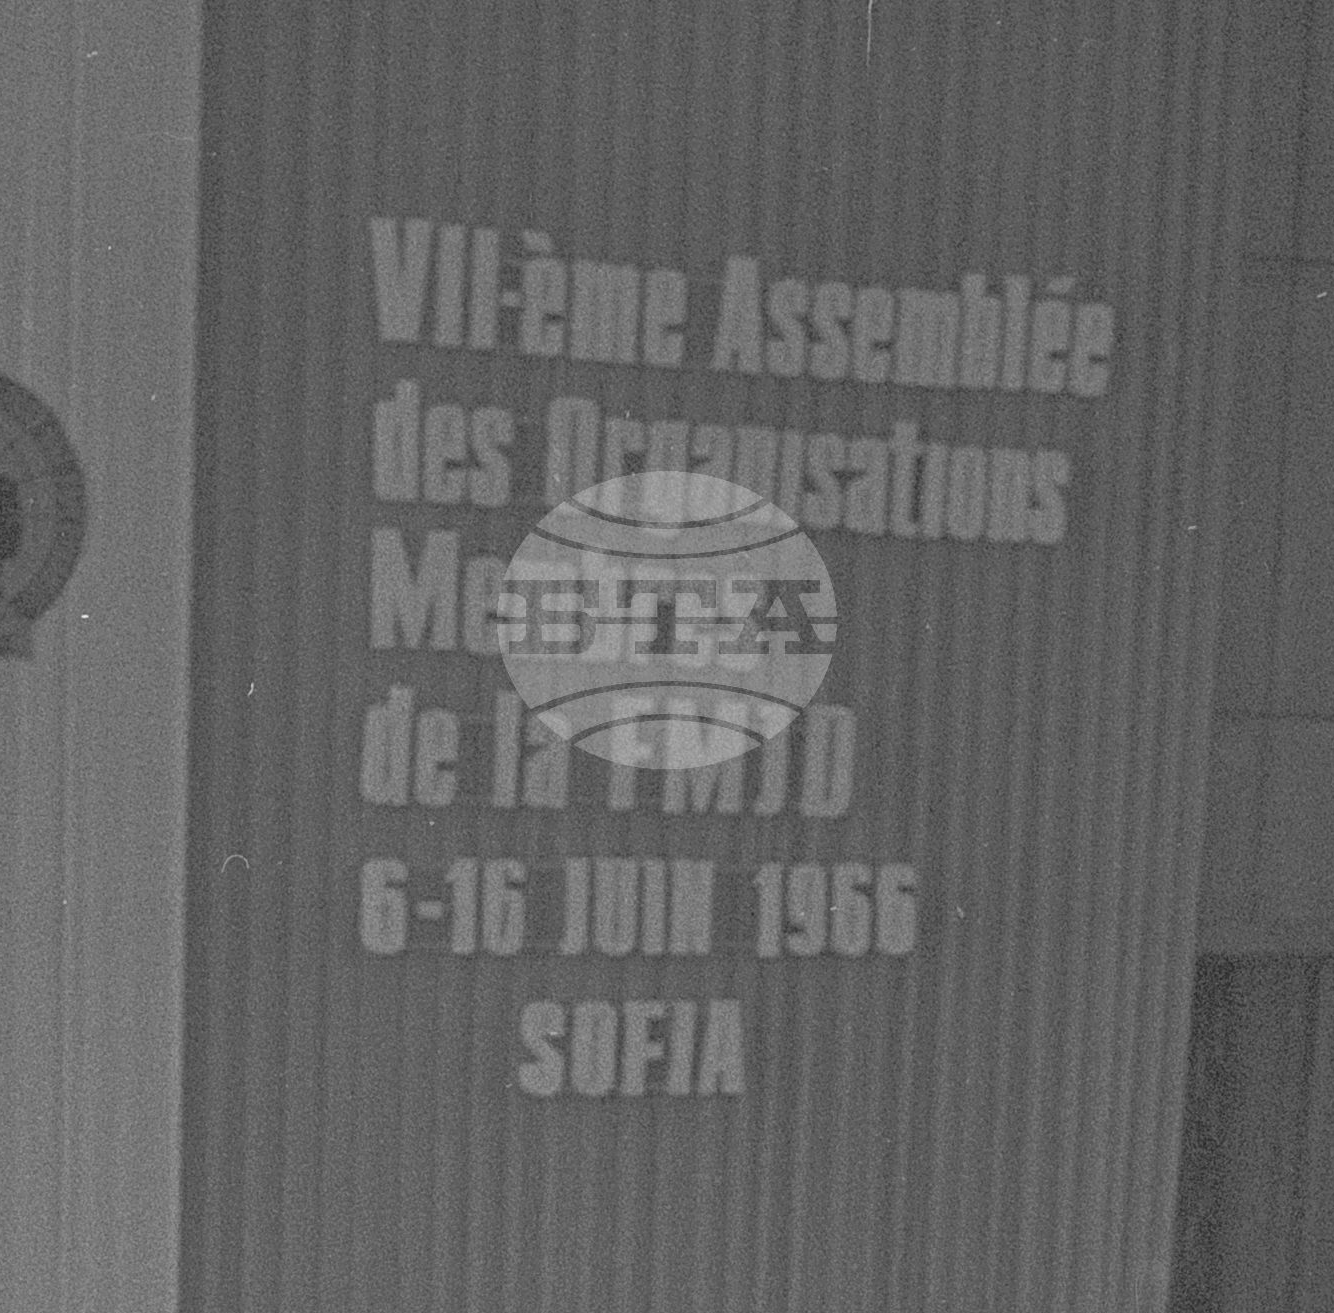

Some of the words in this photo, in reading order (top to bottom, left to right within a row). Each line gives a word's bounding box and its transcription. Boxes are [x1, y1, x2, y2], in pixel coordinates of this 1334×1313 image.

[370, 216, 687, 369] VII-ème
[710, 254, 1115, 397] Assemblée
[371, 378, 516, 507] des
[545, 396, 1071, 545] Organisations
[360, 684, 460, 808] de
[490, 690, 571, 809] la
[608, 695, 856, 819] FMJD
[359, 858, 527, 956] 6-16
[559, 857, 715, 955] JUIN
[753, 861, 919, 958] 1966
[517, 1000, 747, 1096] SOFIA
